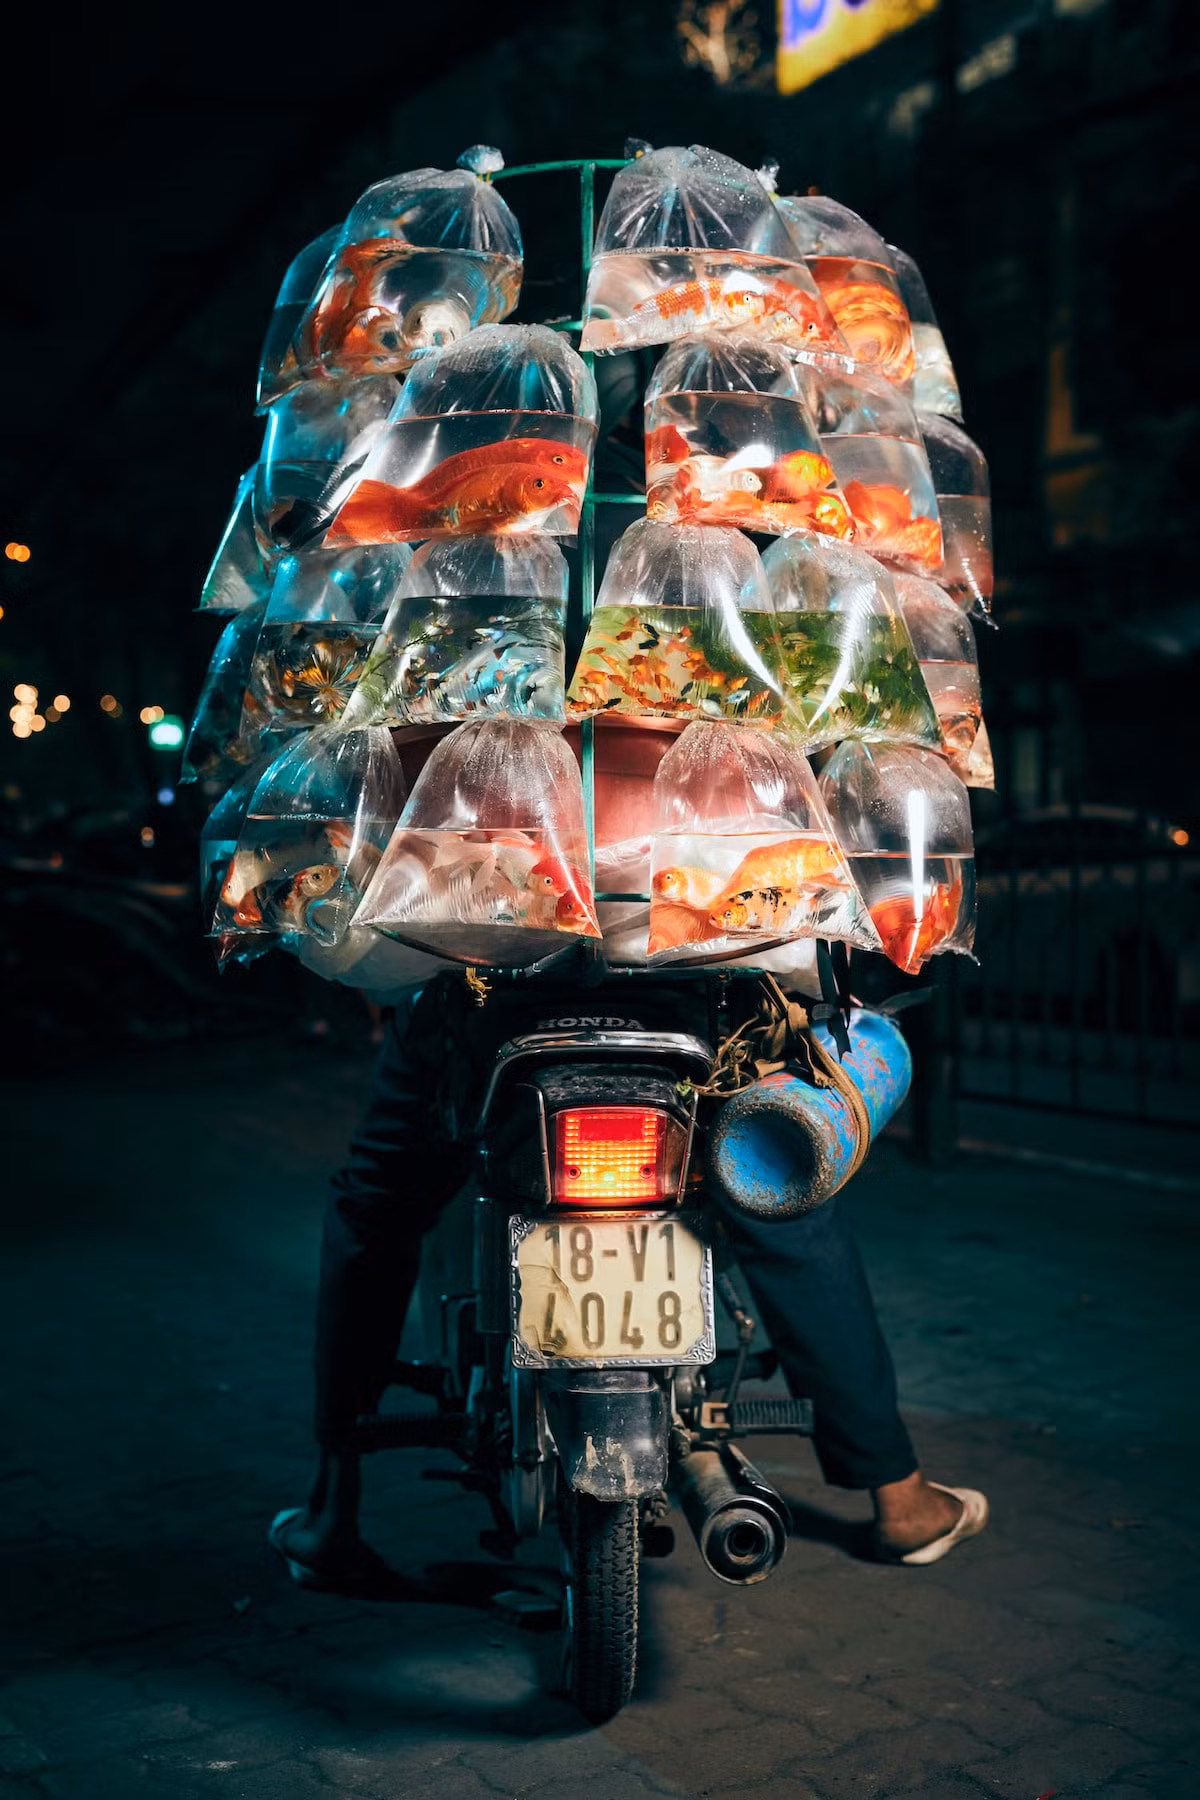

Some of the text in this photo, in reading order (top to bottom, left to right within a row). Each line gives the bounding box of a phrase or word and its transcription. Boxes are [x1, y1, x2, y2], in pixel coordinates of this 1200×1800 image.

[536, 1016, 646, 1031] HONDA
[544, 1223, 676, 1283] 18-V1
[543, 1290, 682, 1350] 4048
